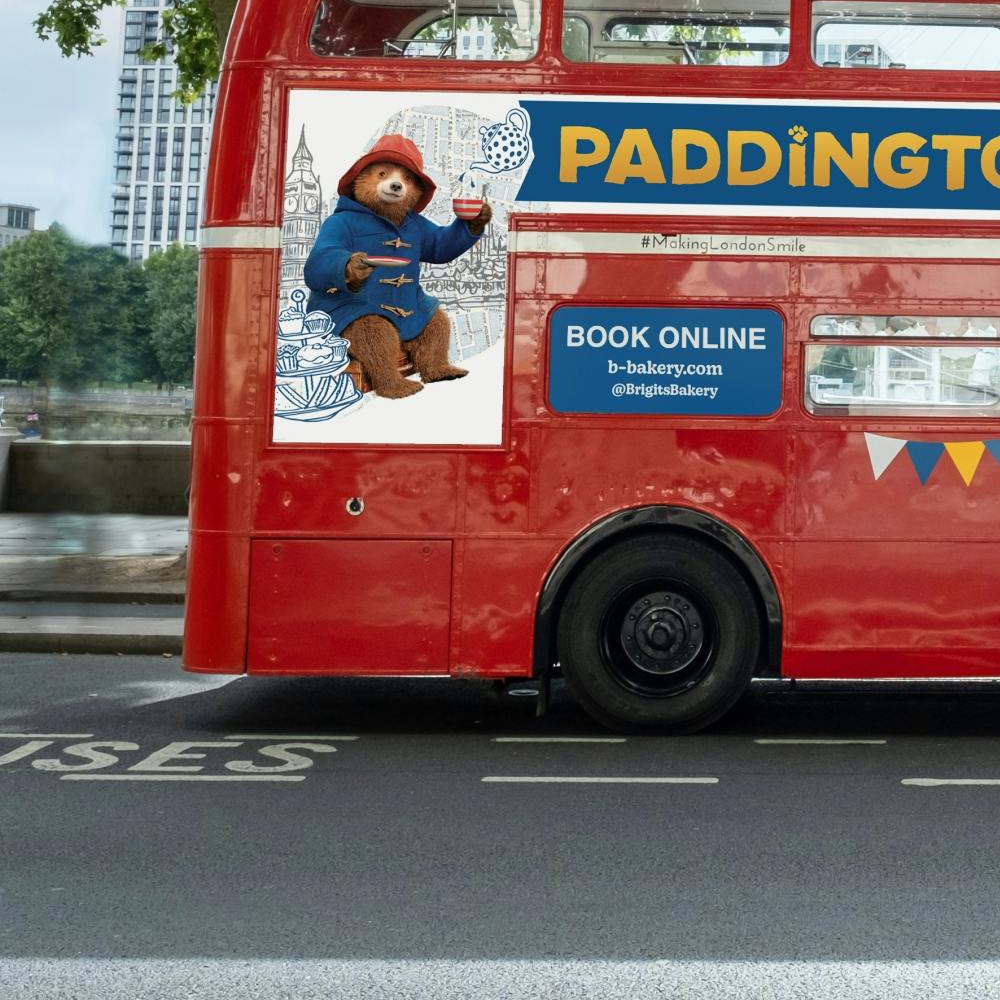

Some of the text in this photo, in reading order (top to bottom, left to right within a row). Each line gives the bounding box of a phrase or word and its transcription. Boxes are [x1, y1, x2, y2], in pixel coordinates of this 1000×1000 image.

[641, 235, 806, 254] #MakingLondonSmile
[566, 325, 767, 350] BOOK ONLINE
[608, 360, 723, 378] b-bakery.com
[611, 382, 718, 399] @BrigitsBakery
